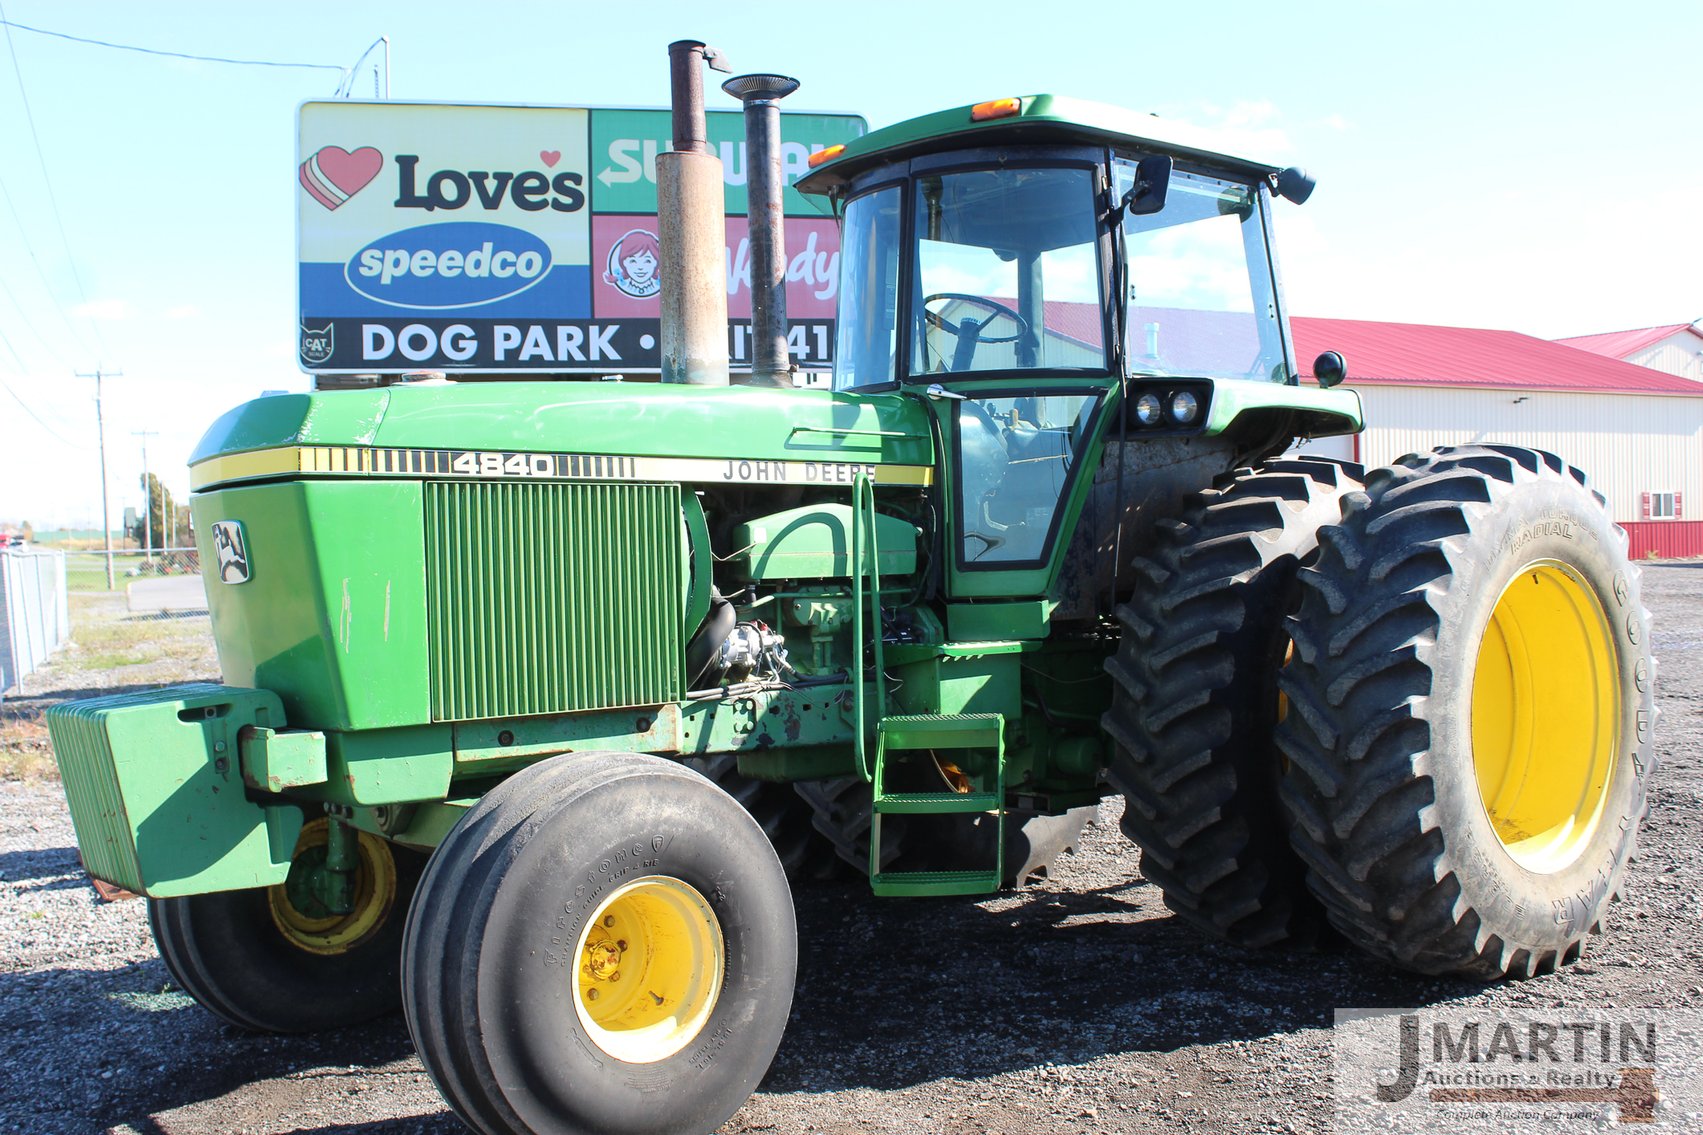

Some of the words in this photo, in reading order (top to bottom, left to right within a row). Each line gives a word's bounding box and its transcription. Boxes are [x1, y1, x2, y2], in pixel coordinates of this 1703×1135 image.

[358, 242, 543, 285] speedco
[305, 338, 327, 351] CAT
[362, 323, 478, 361] DOG
[494, 325, 622, 361] PARK
[787, 325, 828, 360] 41
[454, 454, 555, 477] 4840
[723, 460, 787, 481] JOHN
[805, 463, 876, 483] DEERE
[1511, 521, 1574, 555] RADIAL
